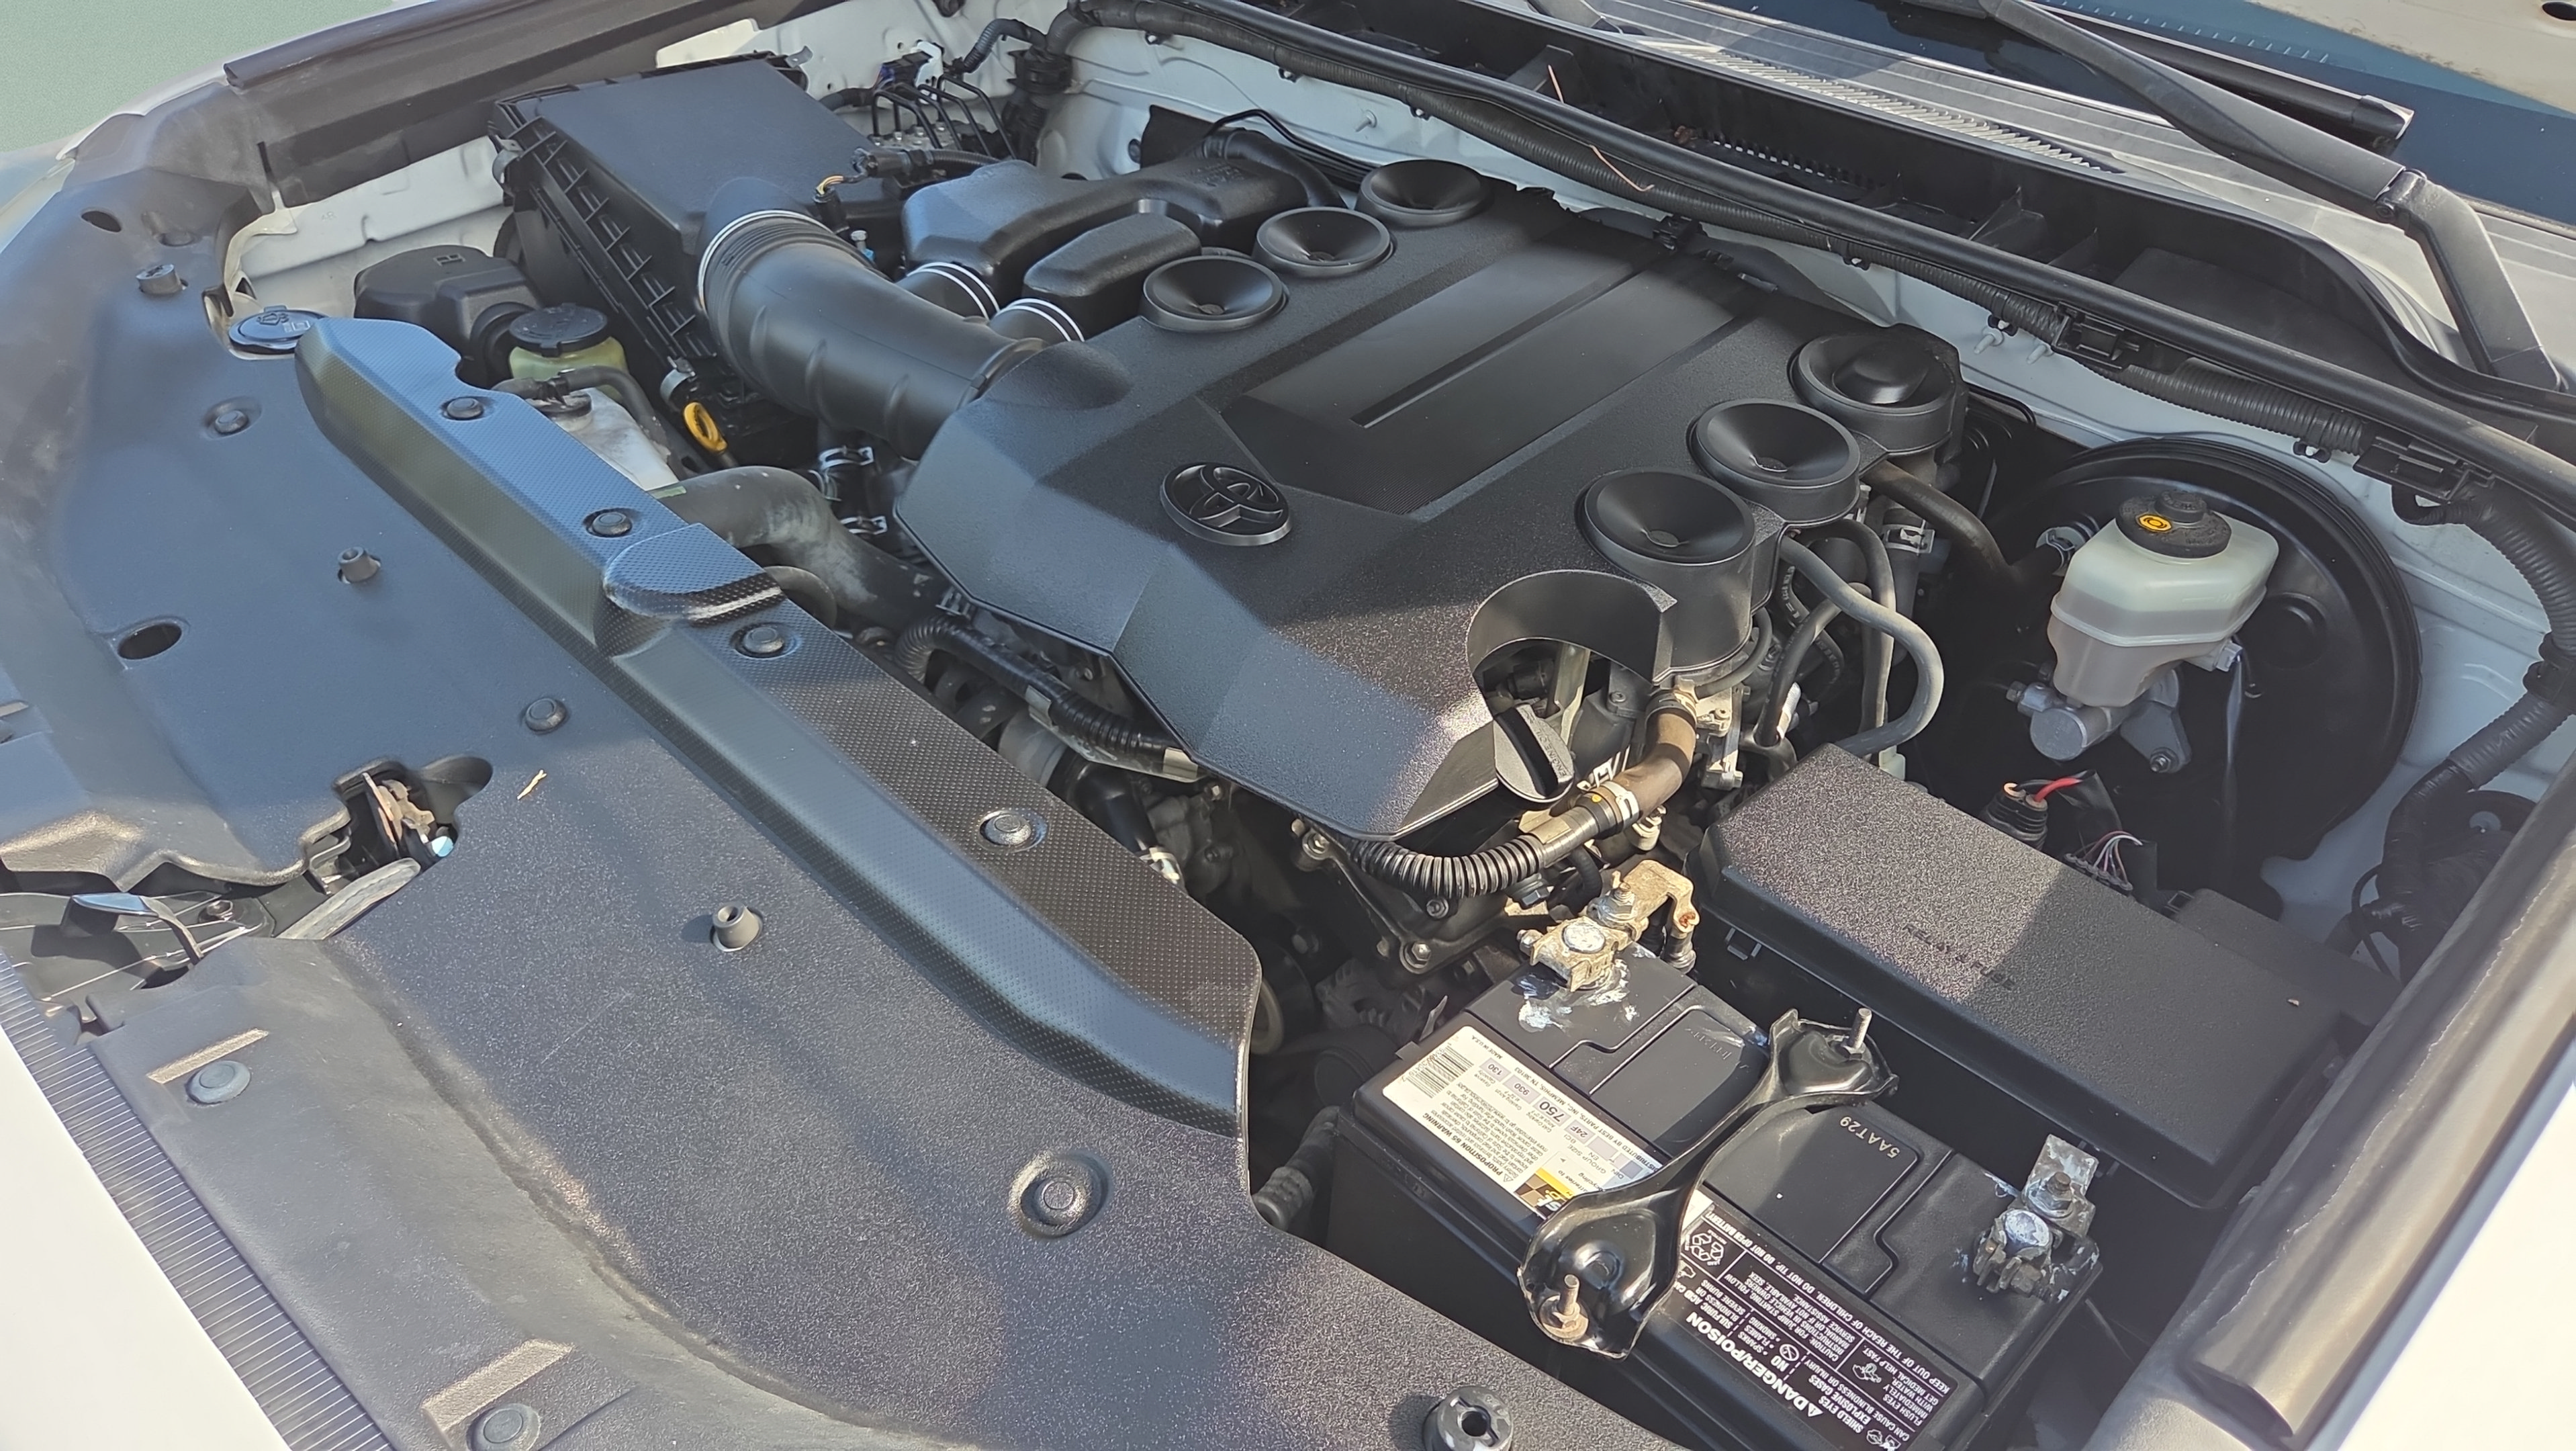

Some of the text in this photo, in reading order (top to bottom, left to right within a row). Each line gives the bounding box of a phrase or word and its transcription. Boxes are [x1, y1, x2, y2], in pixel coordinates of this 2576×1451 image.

[1545, 744, 1567, 777] ENGINE
[1902, 923, 1950, 955] RELAY
[1971, 960, 2015, 991] FUSE
[1486, 1063, 1504, 1075] 130
[1487, 1048, 1503, 1059] MADE
[1512, 1082, 1530, 1096] 930
[1537, 1100, 1566, 1122] 750
[1422, 1112, 1503, 1176] PROPOSITION 65 WARNING
[1569, 1124, 1588, 1138] 24F
[1839, 1116, 1900, 1159] 5AAT29
[1566, 1143, 1607, 1174] GROUP SIZE
[1588, 1151, 1599, 1161] EN
[1564, 1175, 1588, 1194] atteries
[1610, 1168, 1624, 1179] DIN
[1683, 1288, 1703, 1305] ACID
[1694, 1286, 1740, 1322] BLINDNESS OR
[1700, 1278, 1746, 1315] SEVERE BURNS
[1704, 1211, 1951, 1394] KEEP OUT OF THE REACH OF CHILDREN. DO NOT TIP. DO NOT OPEN BATTERY!
[1747, 1270, 1850, 1350] MANUAL OR IF NOT AVAILABLE, SEEK
[1699, 1301, 1734, 1329] SULFURIC
[1723, 1272, 1840, 1362] CAUTION: FOR JUMP STARTING, FOLLOW
[1743, 1278, 1845, 1356] INSTRUCTIONS IN VEHICLE OWNERS
[1747, 1315, 1778, 1340] SMOKING
[1790, 1292, 1855, 1344] SERVICE ASSISTANCE.
[1737, 1330, 1765, 1353] SPARKS
[1743, 1323, 1771, 1346] FLAMES
[1685, 1311, 1810, 1411] DANGER/POISON
[1769, 1354, 1789, 1372] NO
[1859, 1344, 1939, 1406] GET MEDICAL HELP FAST.
[1803, 1358, 1911, 1442] CAN CAUSE BLINDNESS OR INJURY
[1807, 1373, 1872, 1425] EXPLOSIVE GASES
[1882, 1382, 1929, 1419] IMMEDIATELY
[1882, 1393, 1923, 1426] FLUSH EYES
[1888, 1376, 1934, 1413] WITH WATER.
[1816, 1395, 1865, 1434] SHIELD EYES
